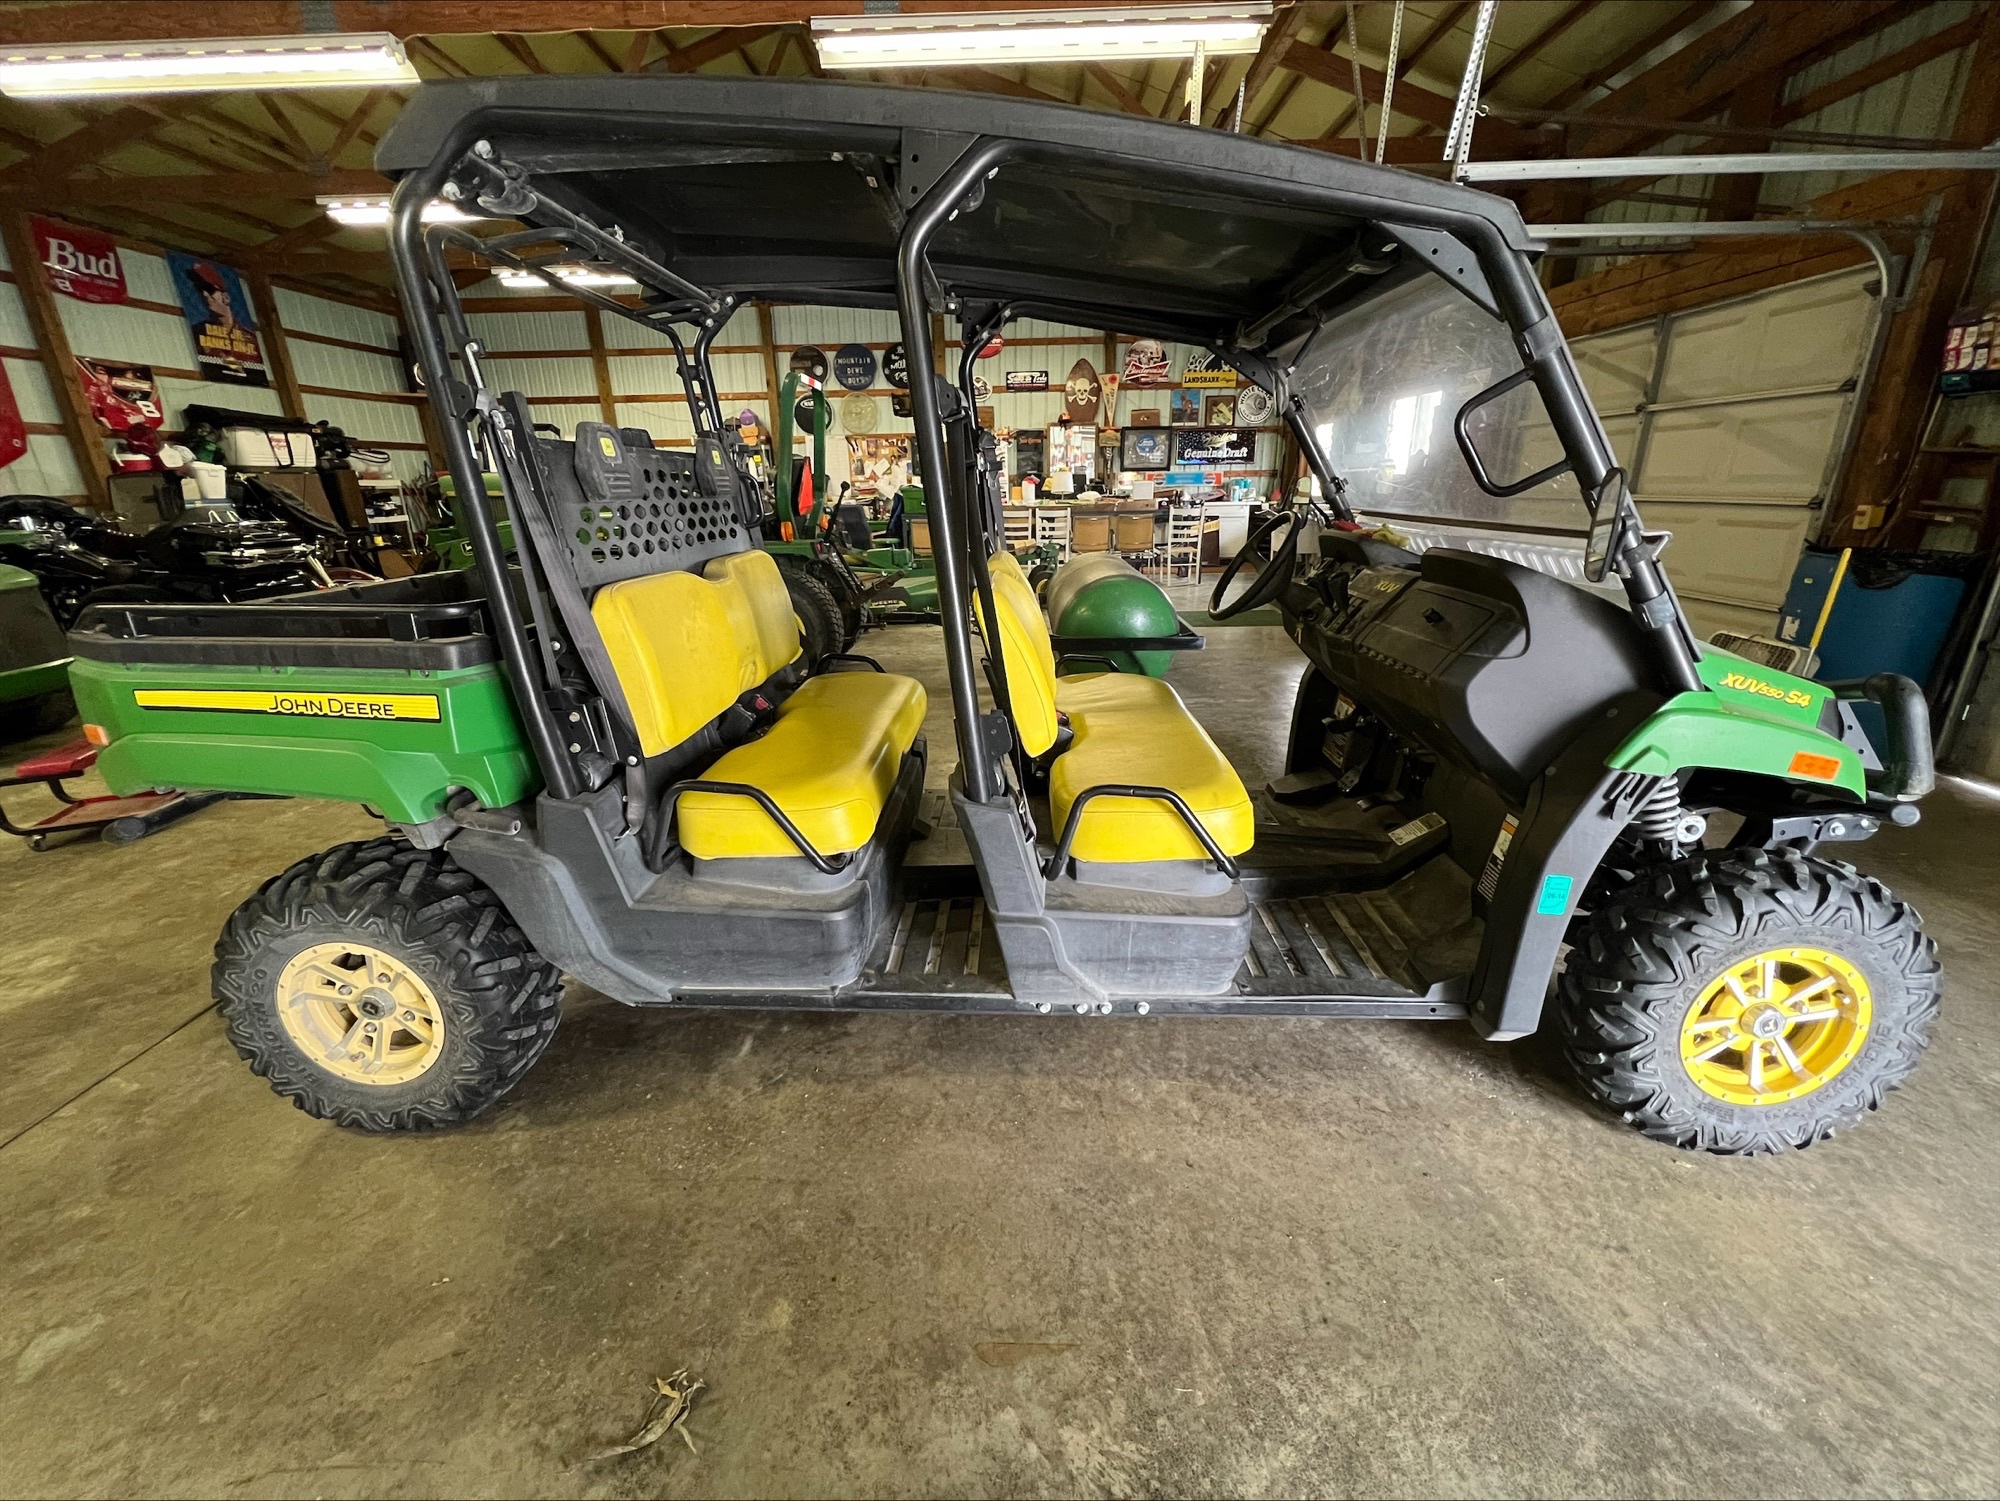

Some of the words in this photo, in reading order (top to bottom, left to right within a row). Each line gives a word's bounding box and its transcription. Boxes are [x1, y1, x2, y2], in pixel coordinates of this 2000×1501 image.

[45, 236, 119, 280] Bud
[205, 323, 230, 339] DALE
[199, 334, 232, 351] BANKS
[837, 357, 871, 365] MOUNTAIN
[1184, 376, 1220, 384] LANDSHARK
[1240, 386, 1256, 405] WHITE
[136, 400, 161, 418] 8
[1184, 447, 1222, 458] Genuine
[1223, 446, 1249, 458] Draft
[1373, 579, 1401, 593] XUV
[1719, 673, 1785, 699] XUV550
[1784, 690, 1811, 707] S4
[268, 695, 323, 715] JOHN
[326, 698, 396, 717] DEERE
